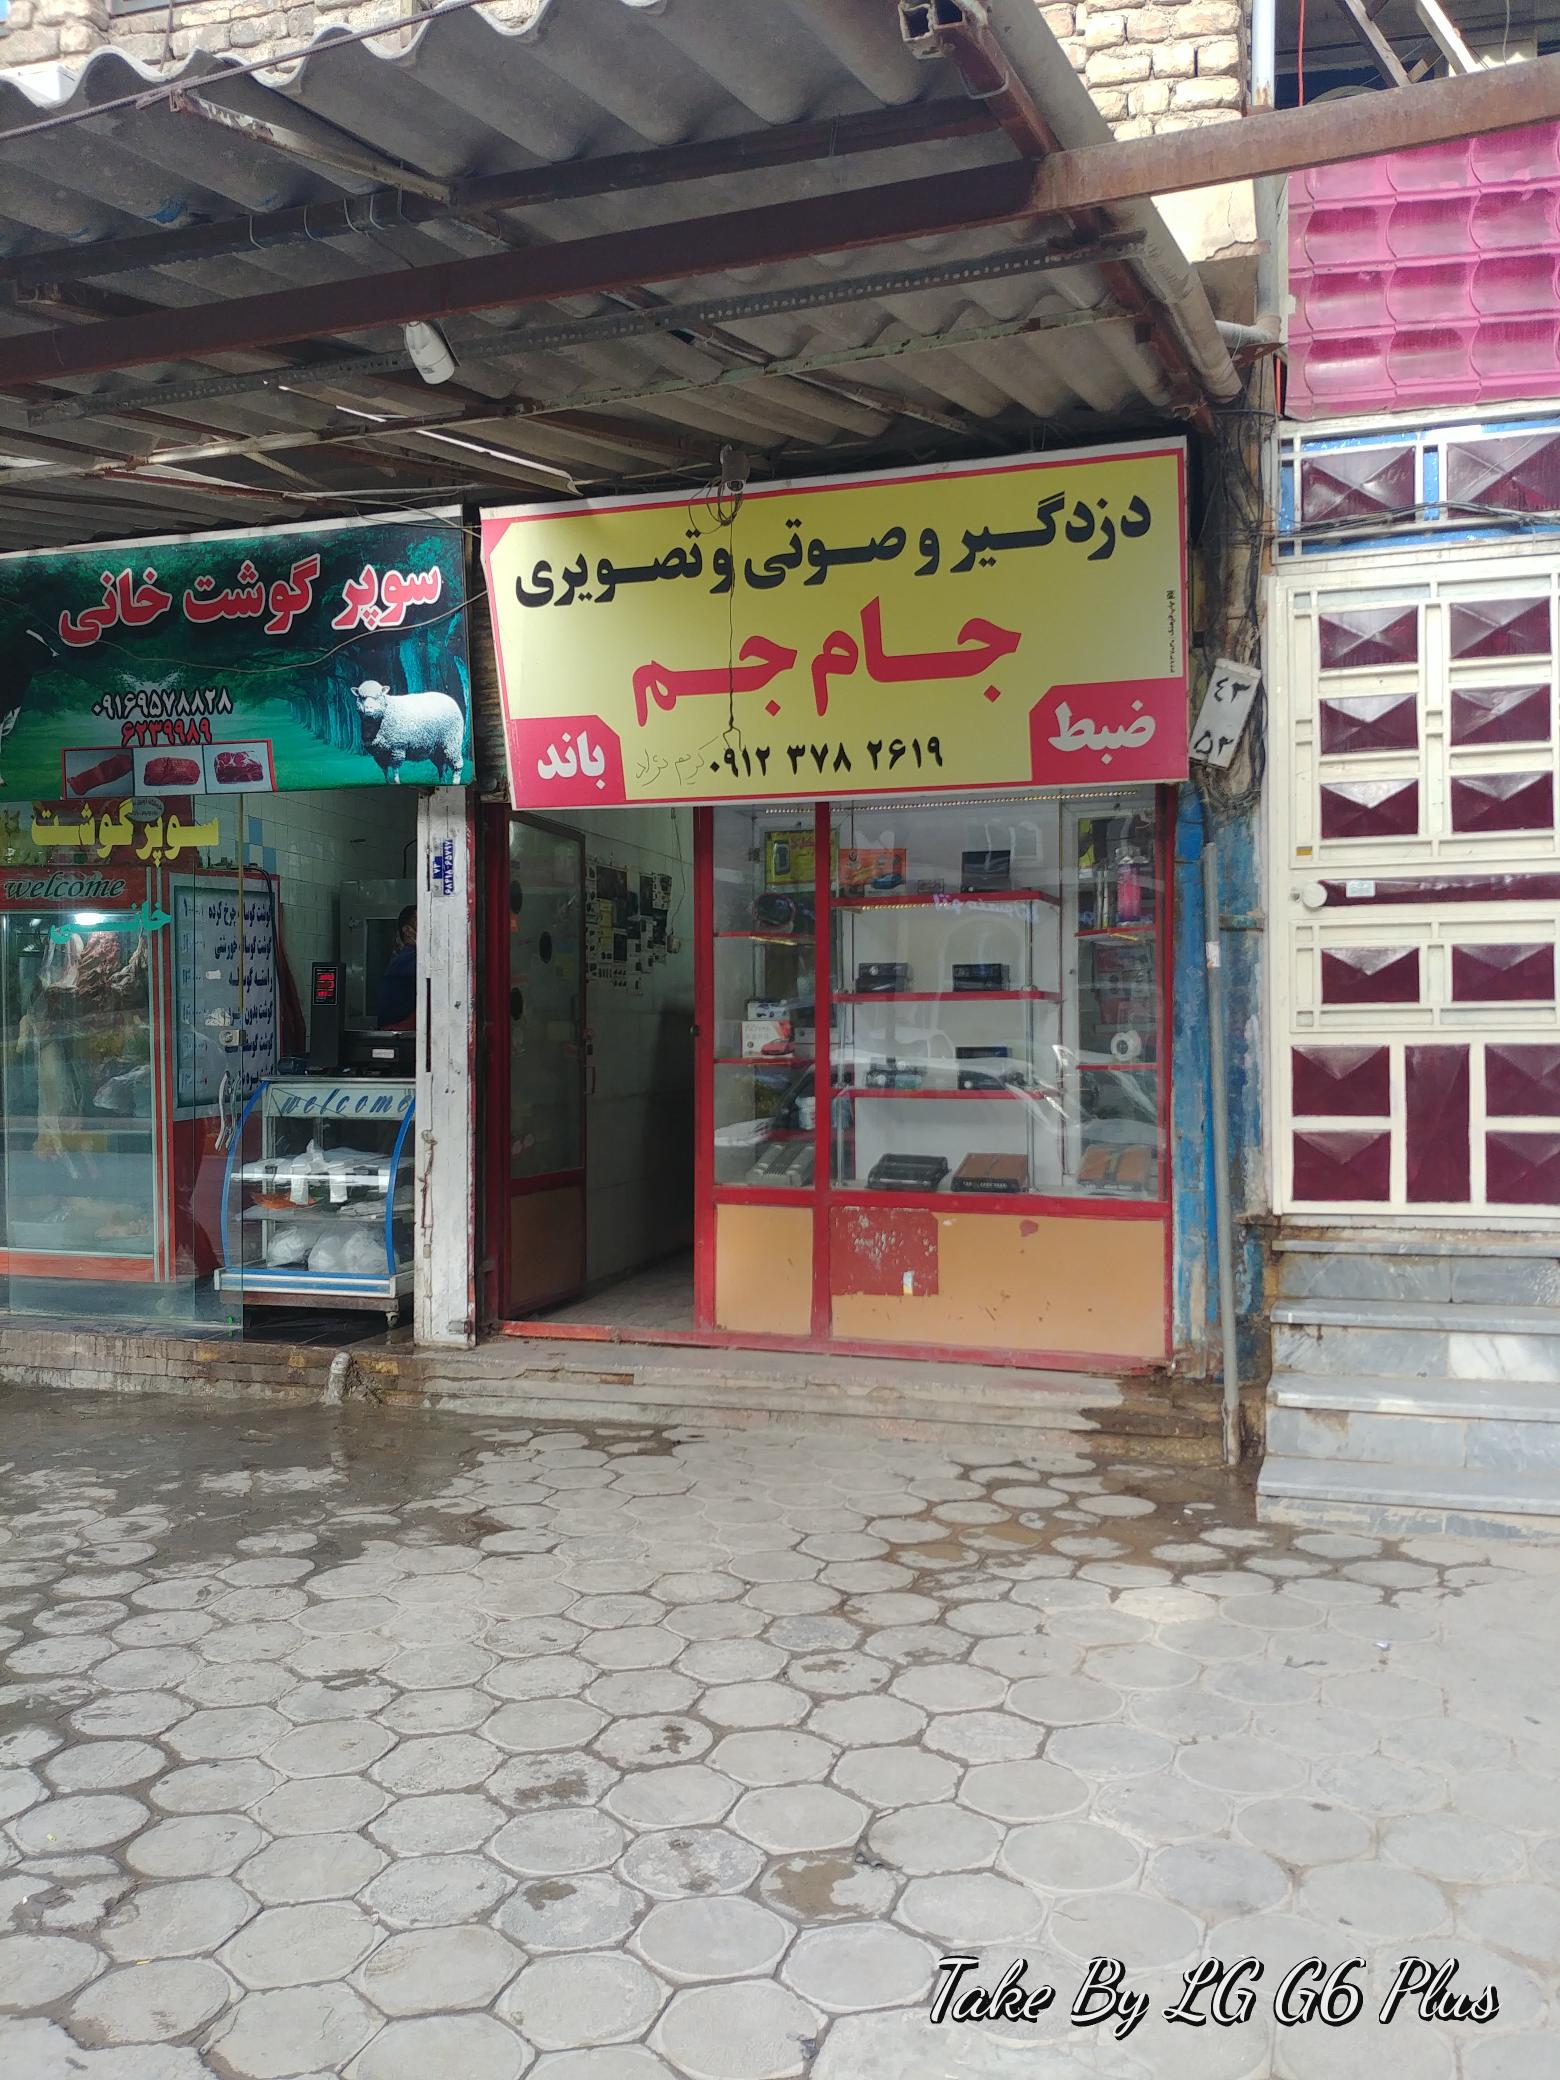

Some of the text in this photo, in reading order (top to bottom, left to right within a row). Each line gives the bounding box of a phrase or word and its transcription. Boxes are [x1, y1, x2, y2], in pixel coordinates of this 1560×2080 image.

[515, 491, 1152, 608] دزدگیر و صوتی و تصویری
[59, 554, 442, 647] سوپر گوشت خانی
[632, 596, 1022, 727] جام جم
[91, 687, 233, 720] ۰۹۱۶۹۵۷۸۸۲۸
[120, 717, 213, 747] ۶۲۳۹۹۸۹
[1048, 700, 1156, 766] ضبط
[537, 730, 606, 790] باند
[709, 736, 943, 778] ۰۹۱۲ ۳۷۸ ۲۶۱۹
[31, 797, 135, 859] گوشت
[4, 870, 126, 900] welcome
[281, 1088, 414, 1114] welcome
